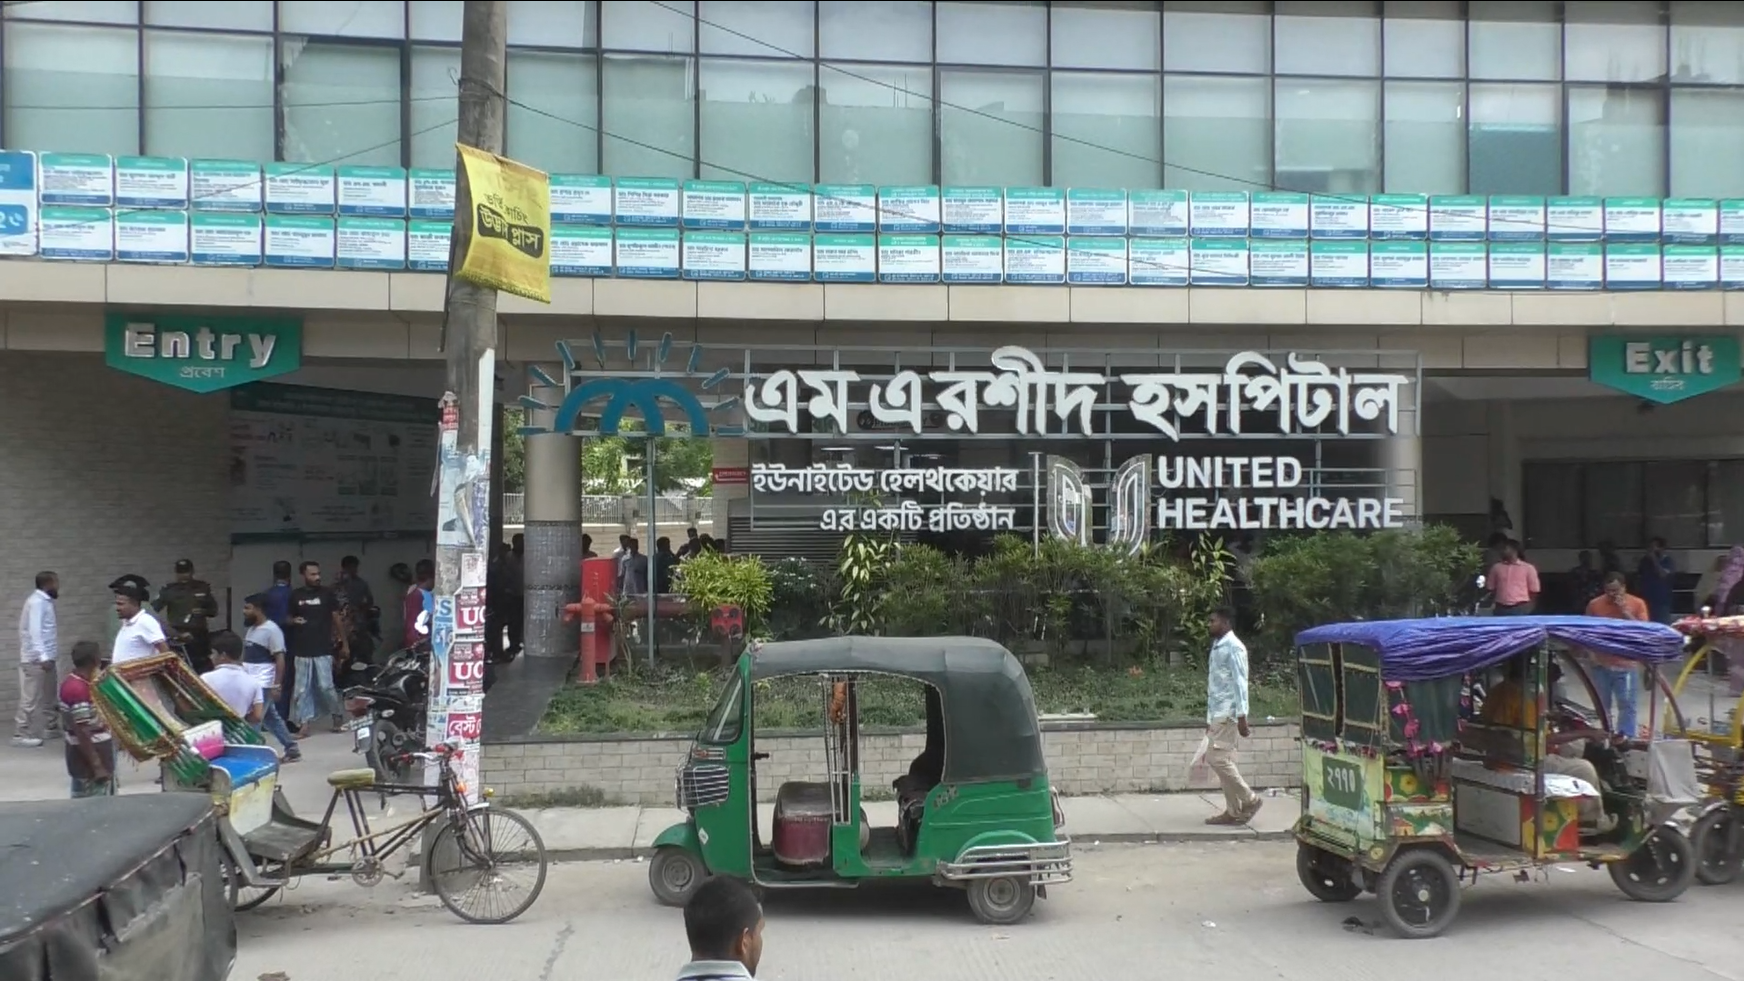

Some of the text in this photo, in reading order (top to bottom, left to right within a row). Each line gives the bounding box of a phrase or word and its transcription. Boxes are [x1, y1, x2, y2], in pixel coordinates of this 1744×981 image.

[124, 322, 276, 369] Entry
[1625, 341, 1714, 374] Exit
[179, 365, 225, 379] প্রবেশ
[744, 369, 861, 434] এম
[1120, 351, 1408, 442] হসপিটাল
[751, 463, 1019, 497] ইউনাইটেড হেলথকেয়ার
[1158, 455, 1302, 488] UNITED
[819, 500, 1015, 533] এর একটি প্রতিষ্ঠান
[1157, 496, 1404, 529] HEALTHCARE
